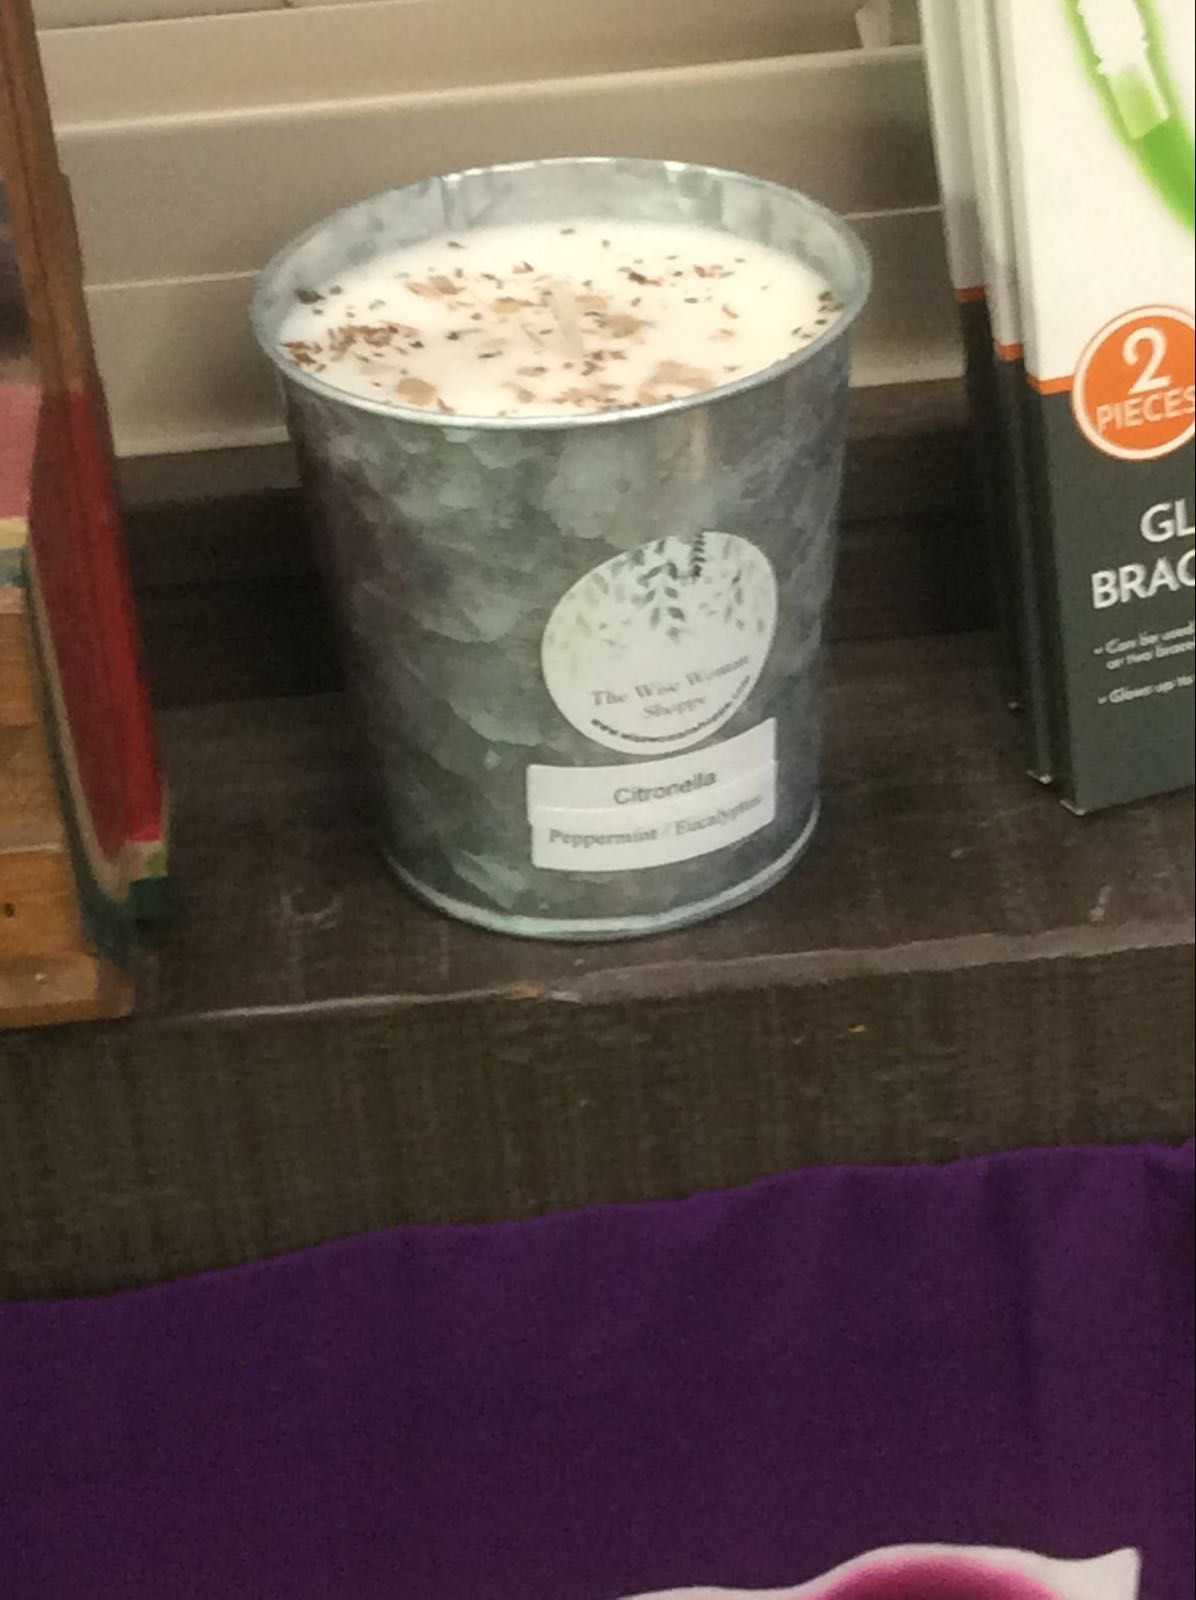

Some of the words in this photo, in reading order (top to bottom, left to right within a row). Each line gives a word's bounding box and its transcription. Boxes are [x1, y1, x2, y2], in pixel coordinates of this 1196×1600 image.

[1122, 326, 1172, 395] 2
[1096, 385, 1195, 434] PIECES
[613, 771, 717, 805] Citronella
[549, 827, 658, 849] Peppermint
